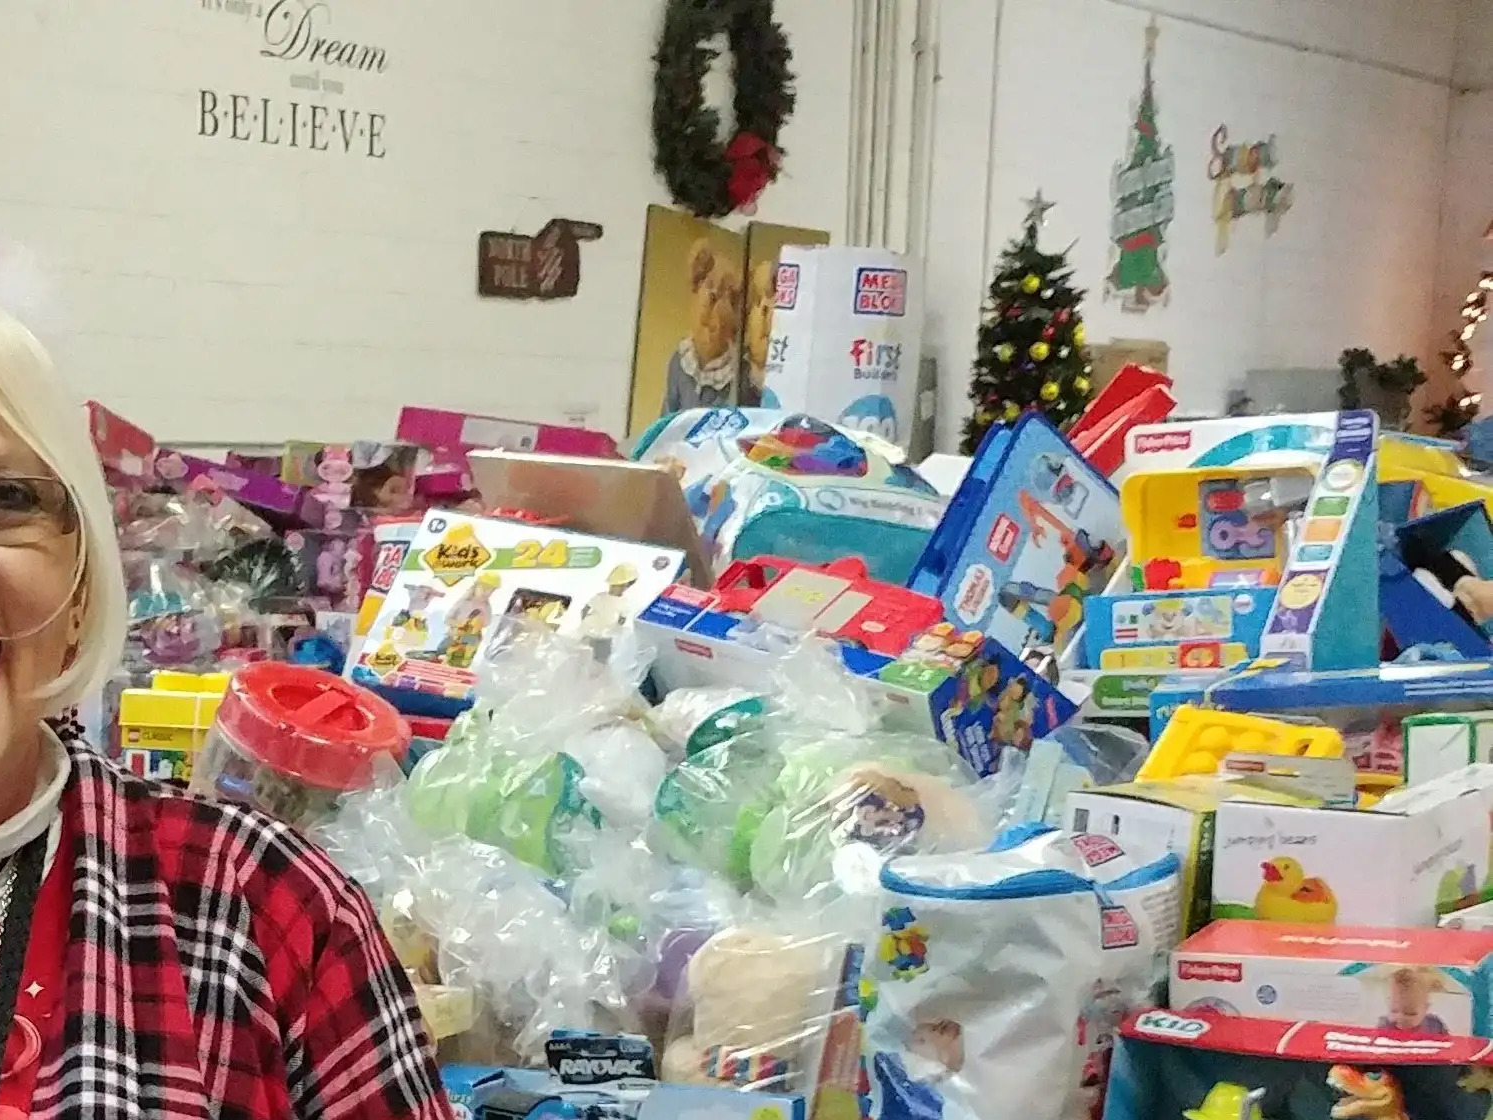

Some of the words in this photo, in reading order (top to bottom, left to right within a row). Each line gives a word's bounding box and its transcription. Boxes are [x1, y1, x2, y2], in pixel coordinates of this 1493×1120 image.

[260, 0, 387, 73] Dream
[511, 539, 568, 568] 24
[1141, 1014, 1204, 1033] KID
[559, 1058, 644, 1077] RAYOVAC
